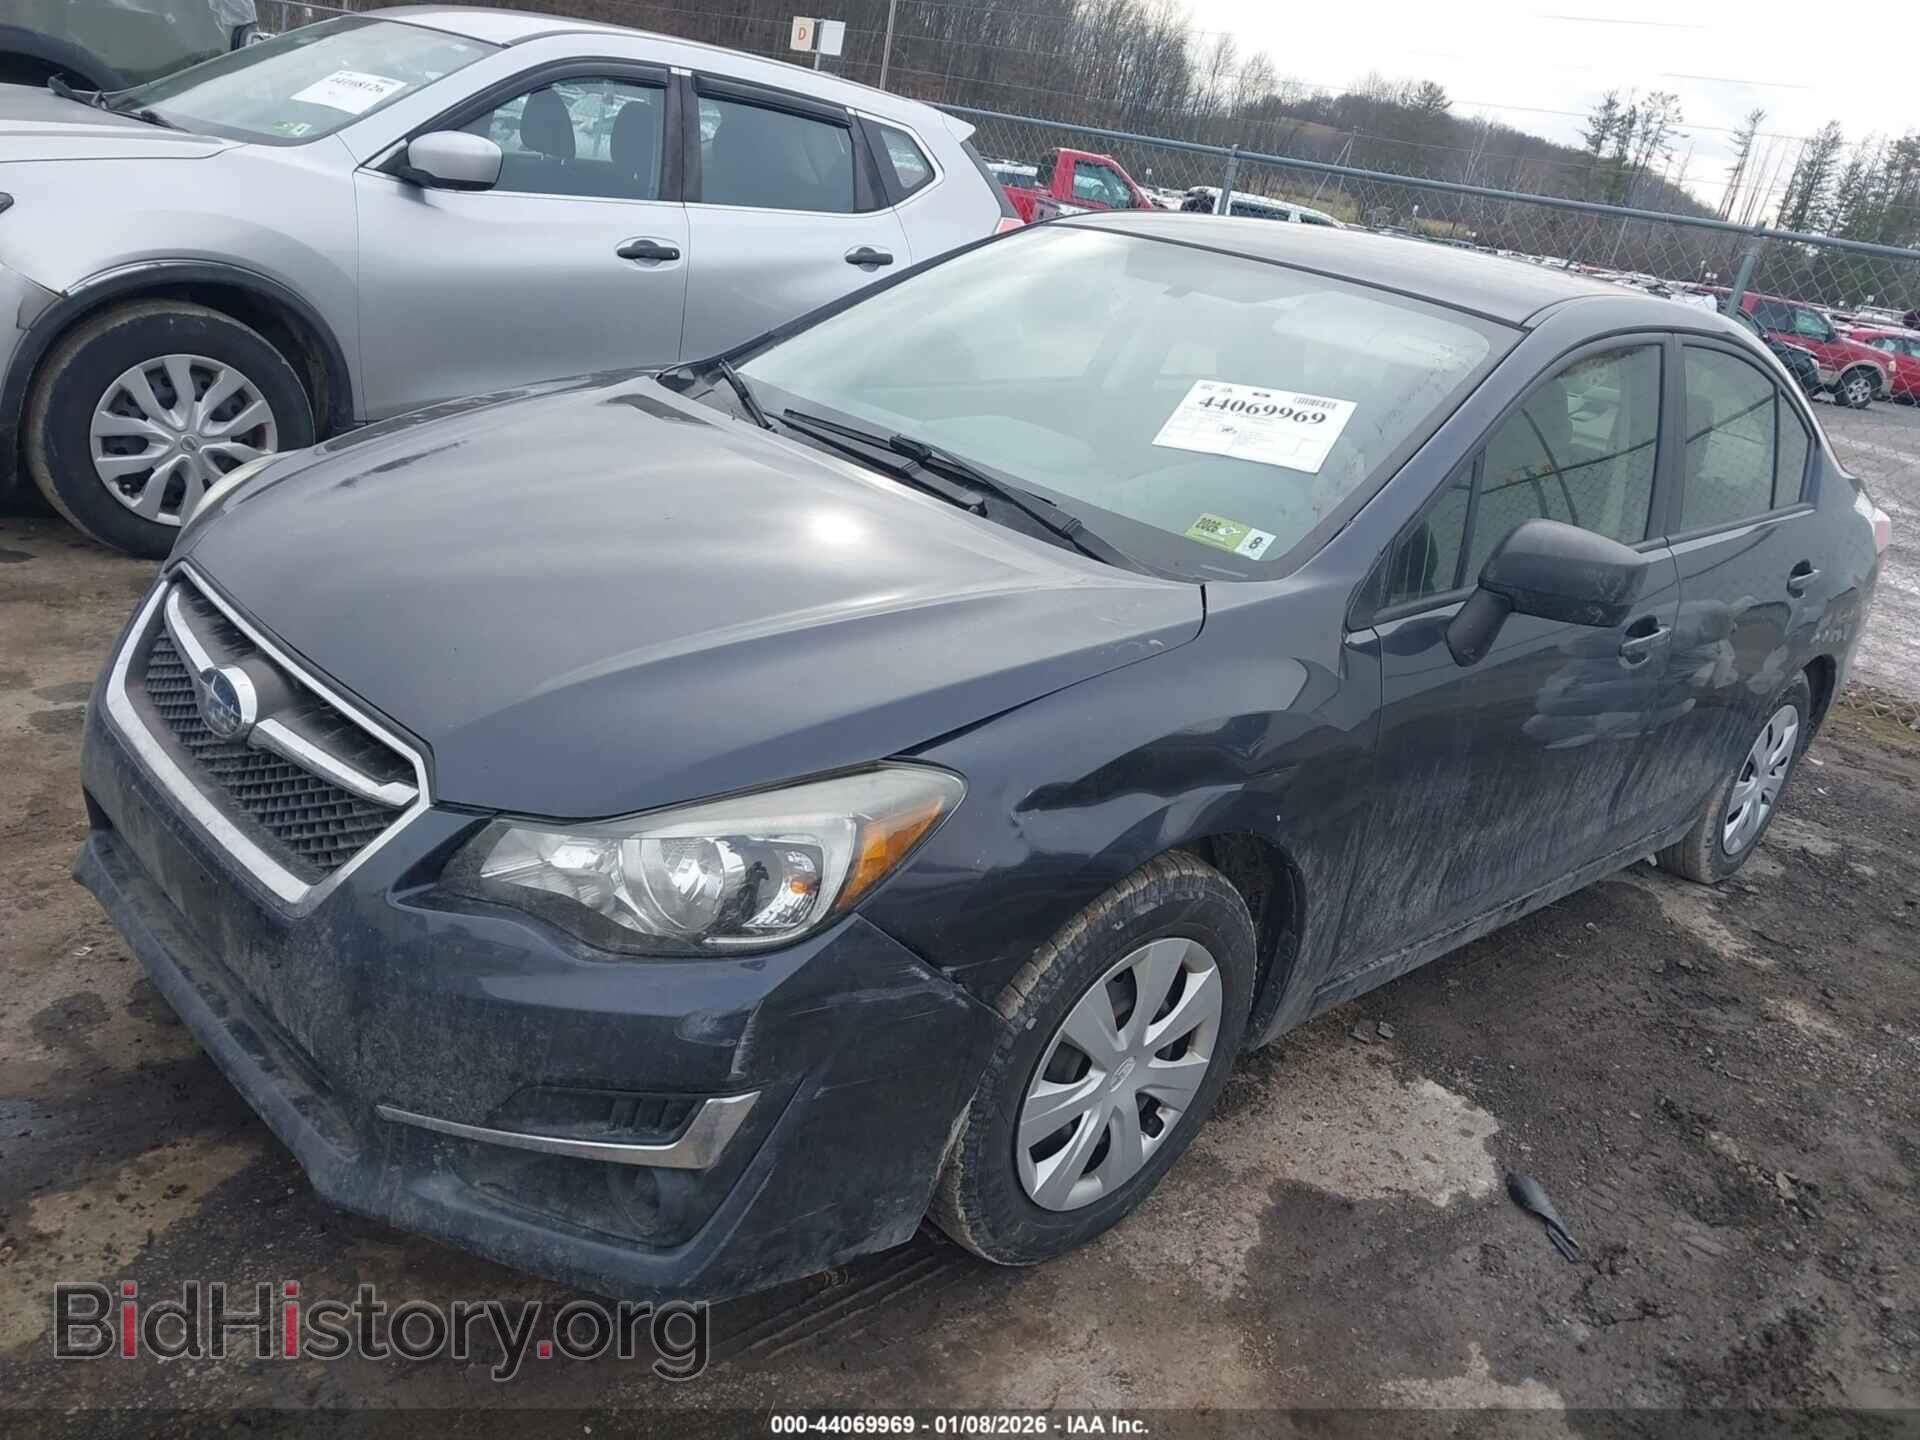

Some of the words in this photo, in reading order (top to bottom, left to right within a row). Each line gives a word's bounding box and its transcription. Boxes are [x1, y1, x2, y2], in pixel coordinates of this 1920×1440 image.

[798, 26, 807, 41] D
[1197, 395, 1327, 425] 44069969
[1248, 536, 1264, 550] 8
